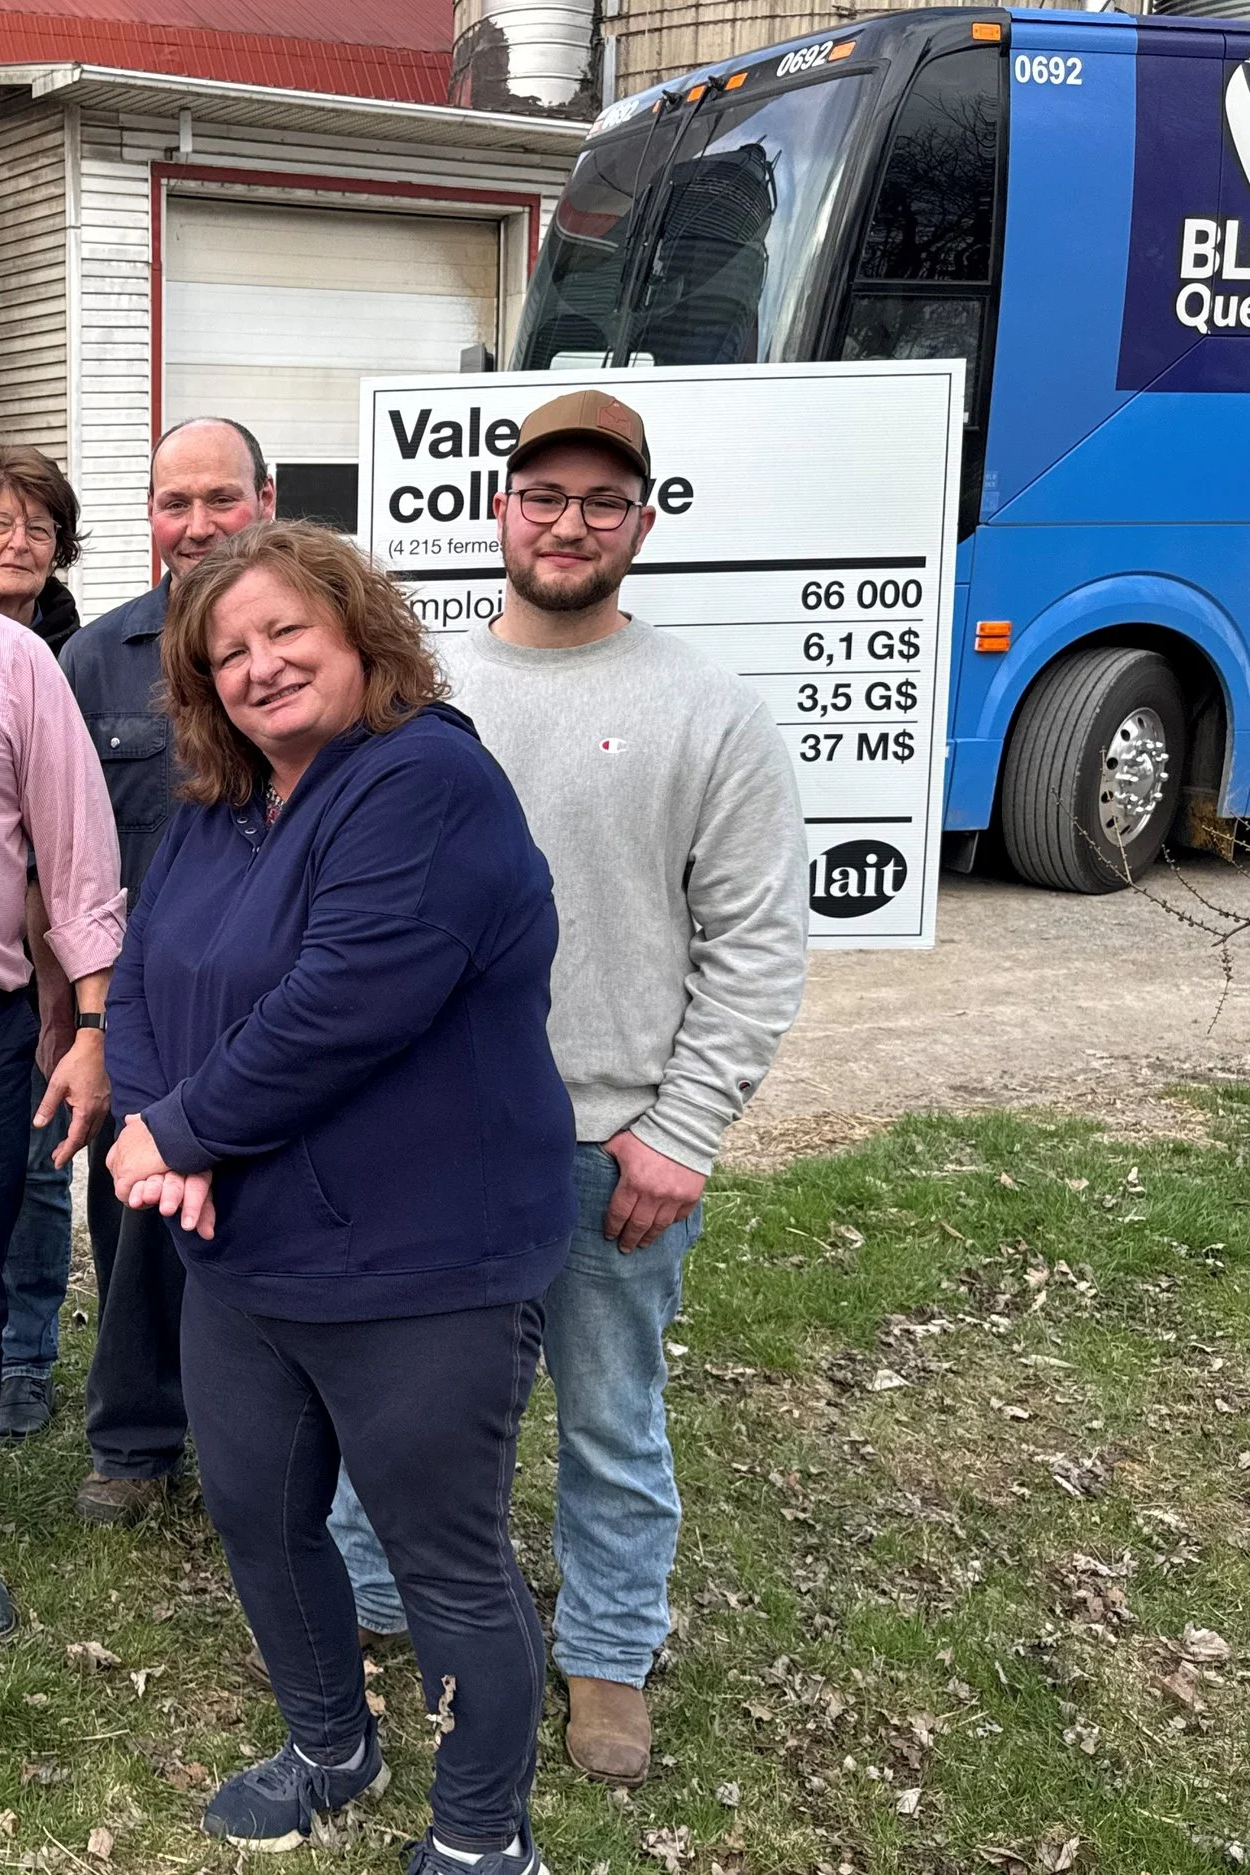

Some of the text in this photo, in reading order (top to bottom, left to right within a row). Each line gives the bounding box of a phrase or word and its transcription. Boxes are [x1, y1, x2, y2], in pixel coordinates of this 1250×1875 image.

[776, 41, 833, 77] 0692
[1014, 55, 1082, 85] 0692
[1180, 218, 1250, 280] BL
[388, 406, 519, 460] Vale
[388, 537, 503, 560] (4 215 ferme
[401, 589, 503, 627] mploi
[801, 579, 922, 610] 66 000
[803, 626, 920, 667] 6,1 G$
[797, 678, 917, 717] 3,5 G$
[800, 729, 914, 764] 37 M$
[812, 853, 904, 898] lait
